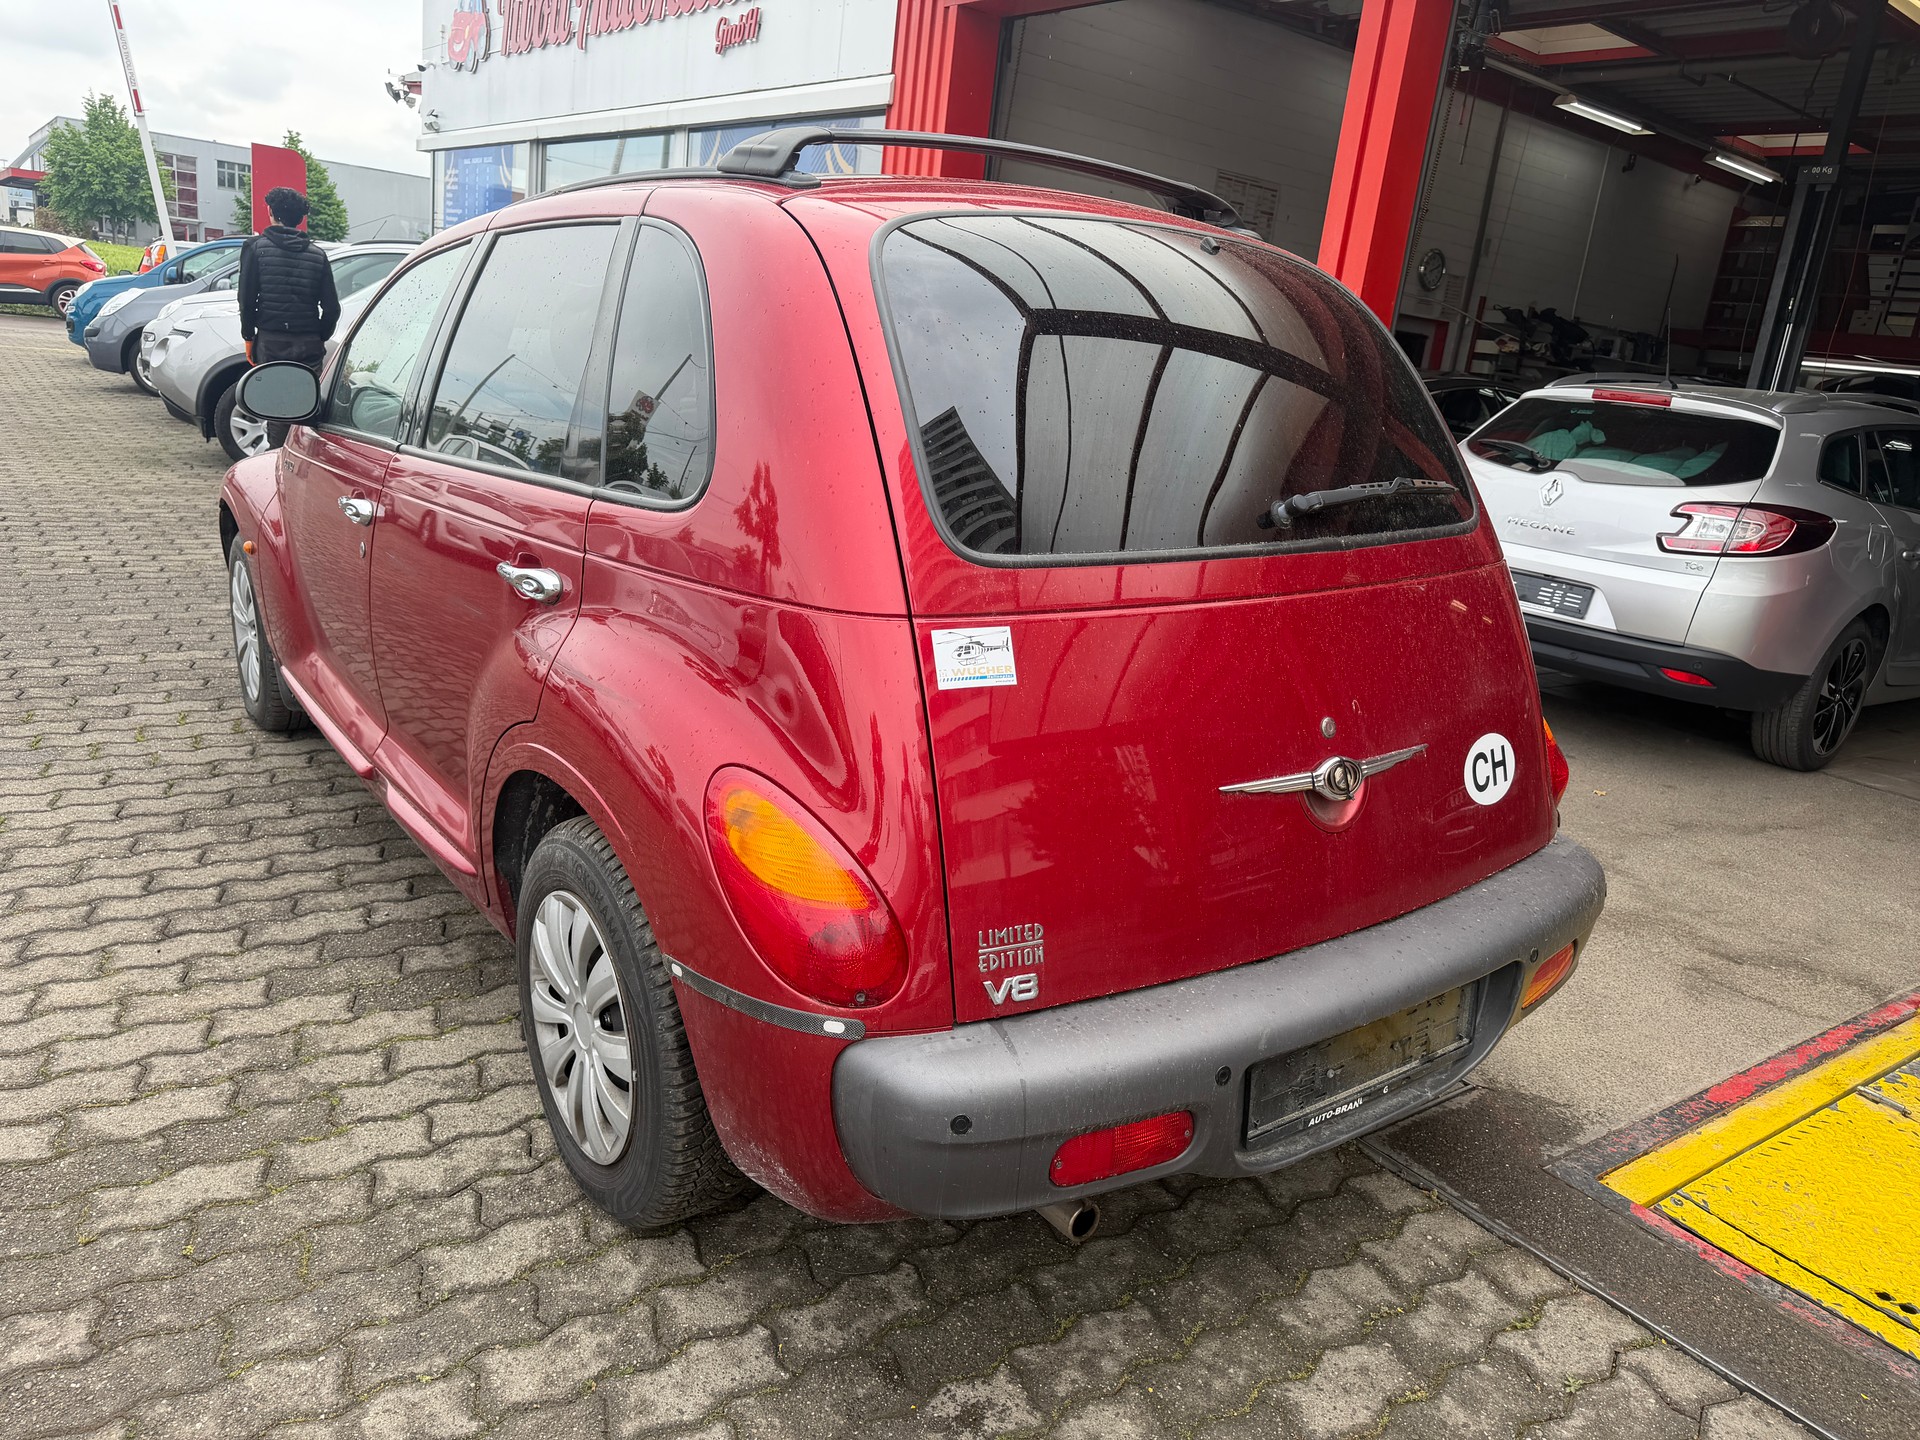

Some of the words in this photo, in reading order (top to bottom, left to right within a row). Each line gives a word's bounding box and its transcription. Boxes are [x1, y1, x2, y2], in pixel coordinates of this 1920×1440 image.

[119, 32, 128, 50] AUTO
[715, 7, 760, 55] GmbH
[123, 51, 133, 71] TIVOLI
[1507, 516, 1576, 536] MEGANE
[951, 665, 1013, 677] WUCHER
[1472, 744, 1508, 793] CH
[978, 922, 1044, 947] LIMITED
[978, 946, 1044, 973] EDITION
[982, 972, 1039, 1006] V8
